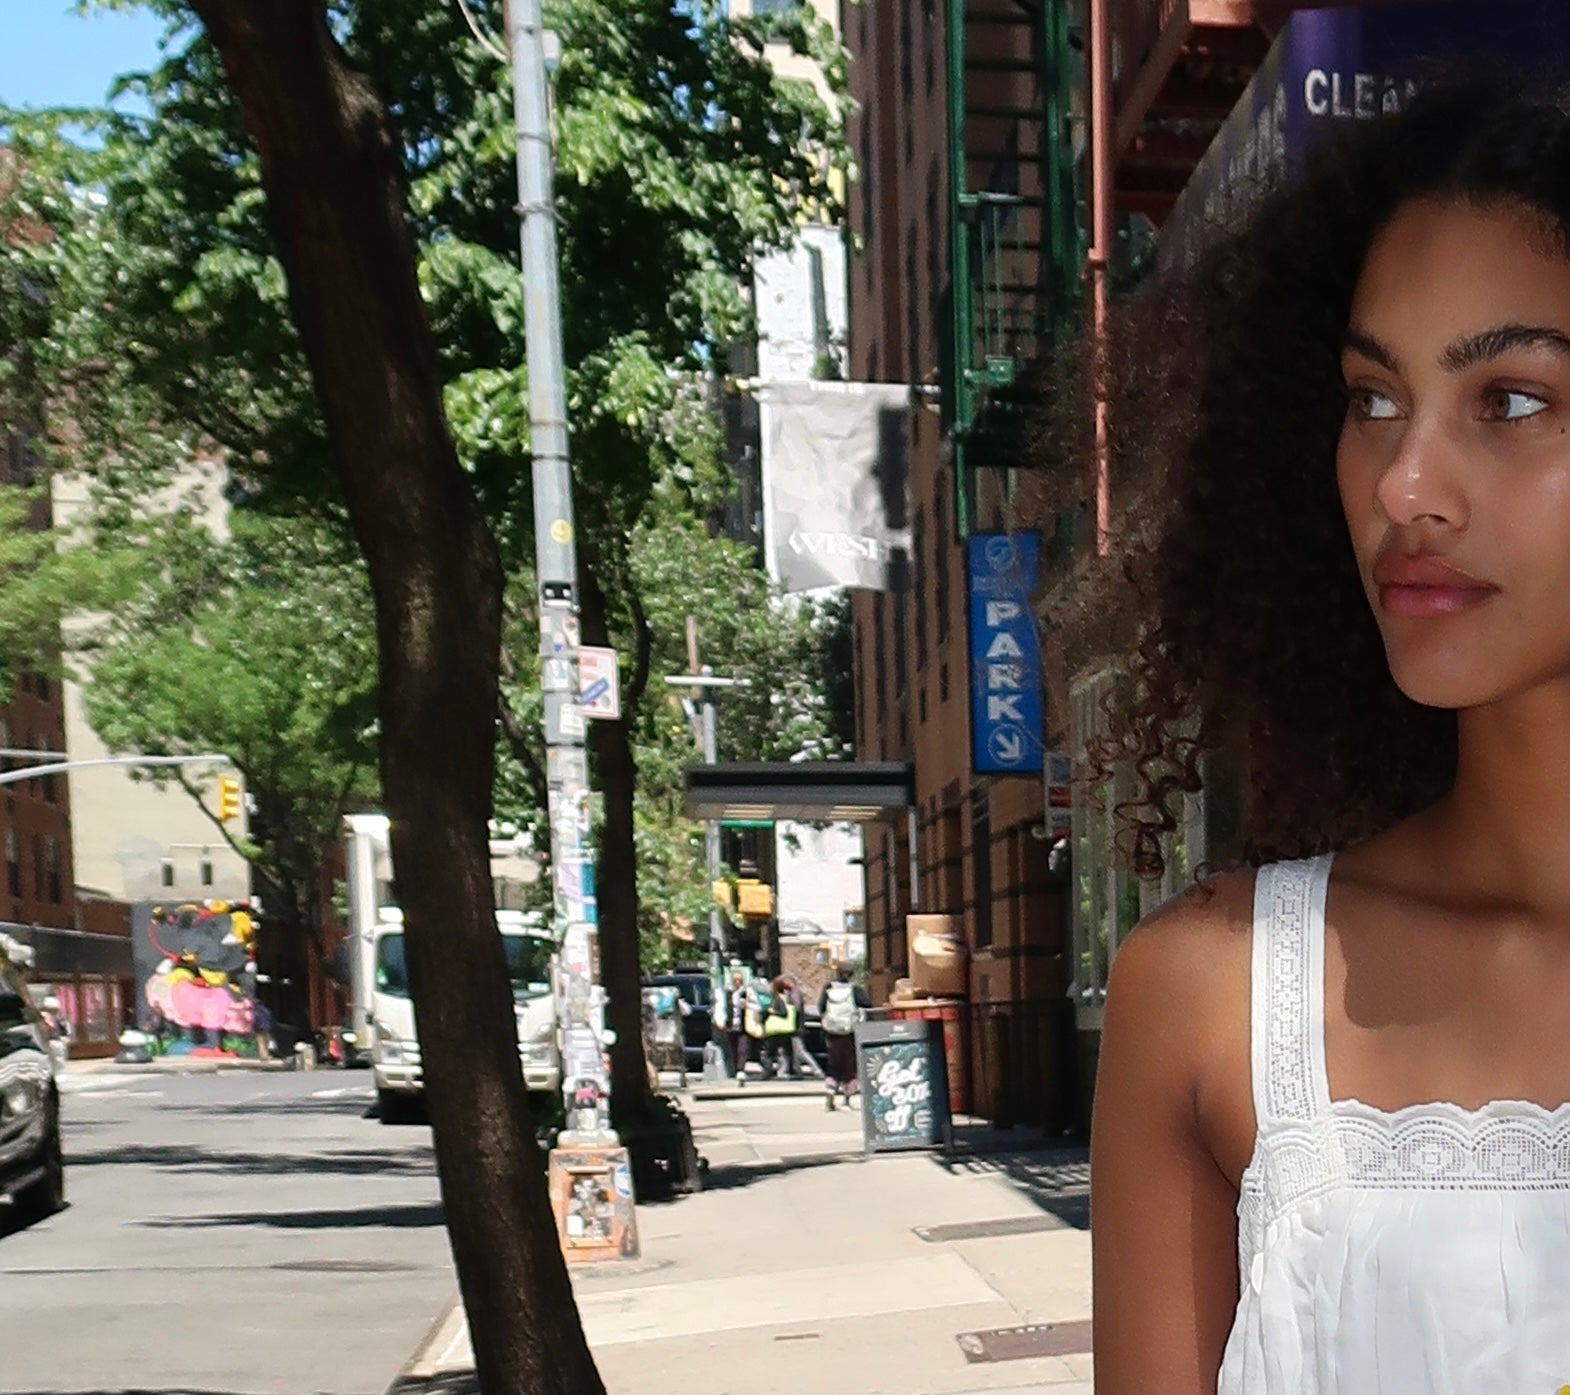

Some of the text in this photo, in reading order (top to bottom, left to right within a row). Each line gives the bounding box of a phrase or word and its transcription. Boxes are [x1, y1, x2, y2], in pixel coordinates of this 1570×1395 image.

[1304, 69, 1419, 119] CLEA
[985, 600, 1025, 721] PARK
[878, 1056, 927, 1098] Get
[884, 1103, 913, 1133] off
